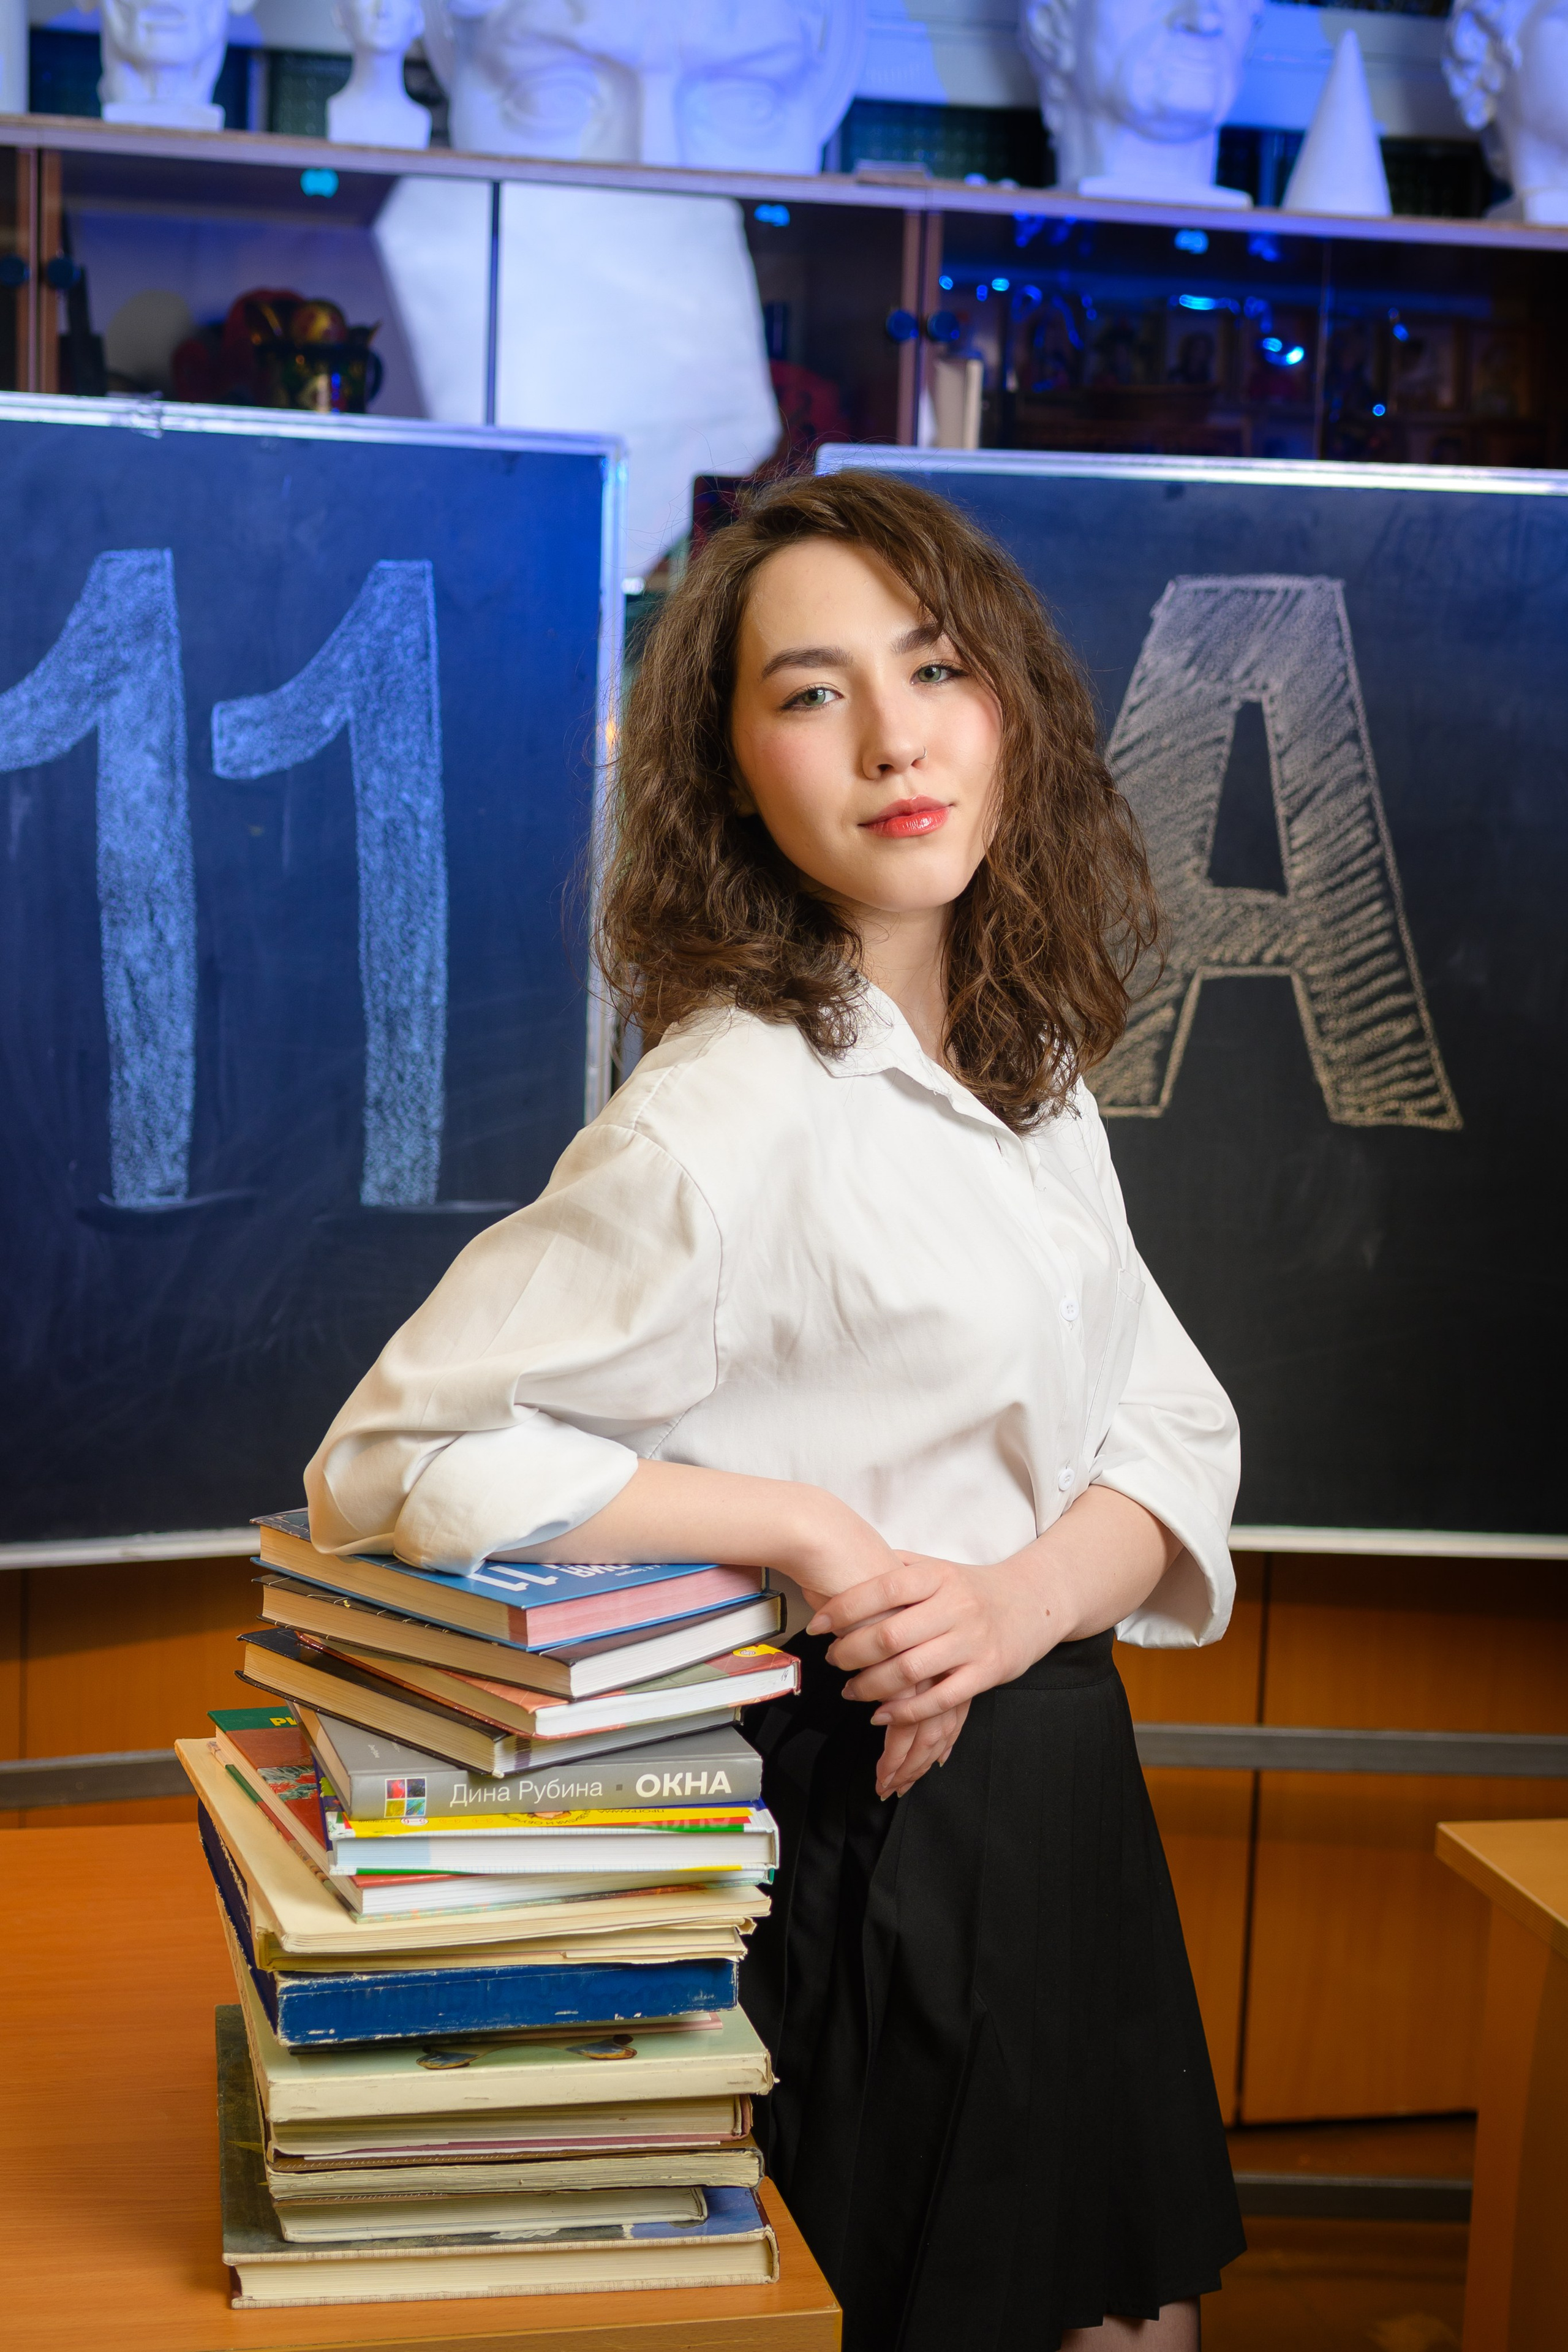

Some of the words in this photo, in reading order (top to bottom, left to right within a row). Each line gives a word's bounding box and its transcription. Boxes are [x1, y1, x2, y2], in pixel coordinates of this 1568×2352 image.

[0, 548, 448, 1207] 11
[467, 1566, 559, 1591] 11
[450, 1784, 511, 1807] Дина
[518, 1777, 603, 1804] Рубина
[635, 1770, 732, 1798] ОКНА
